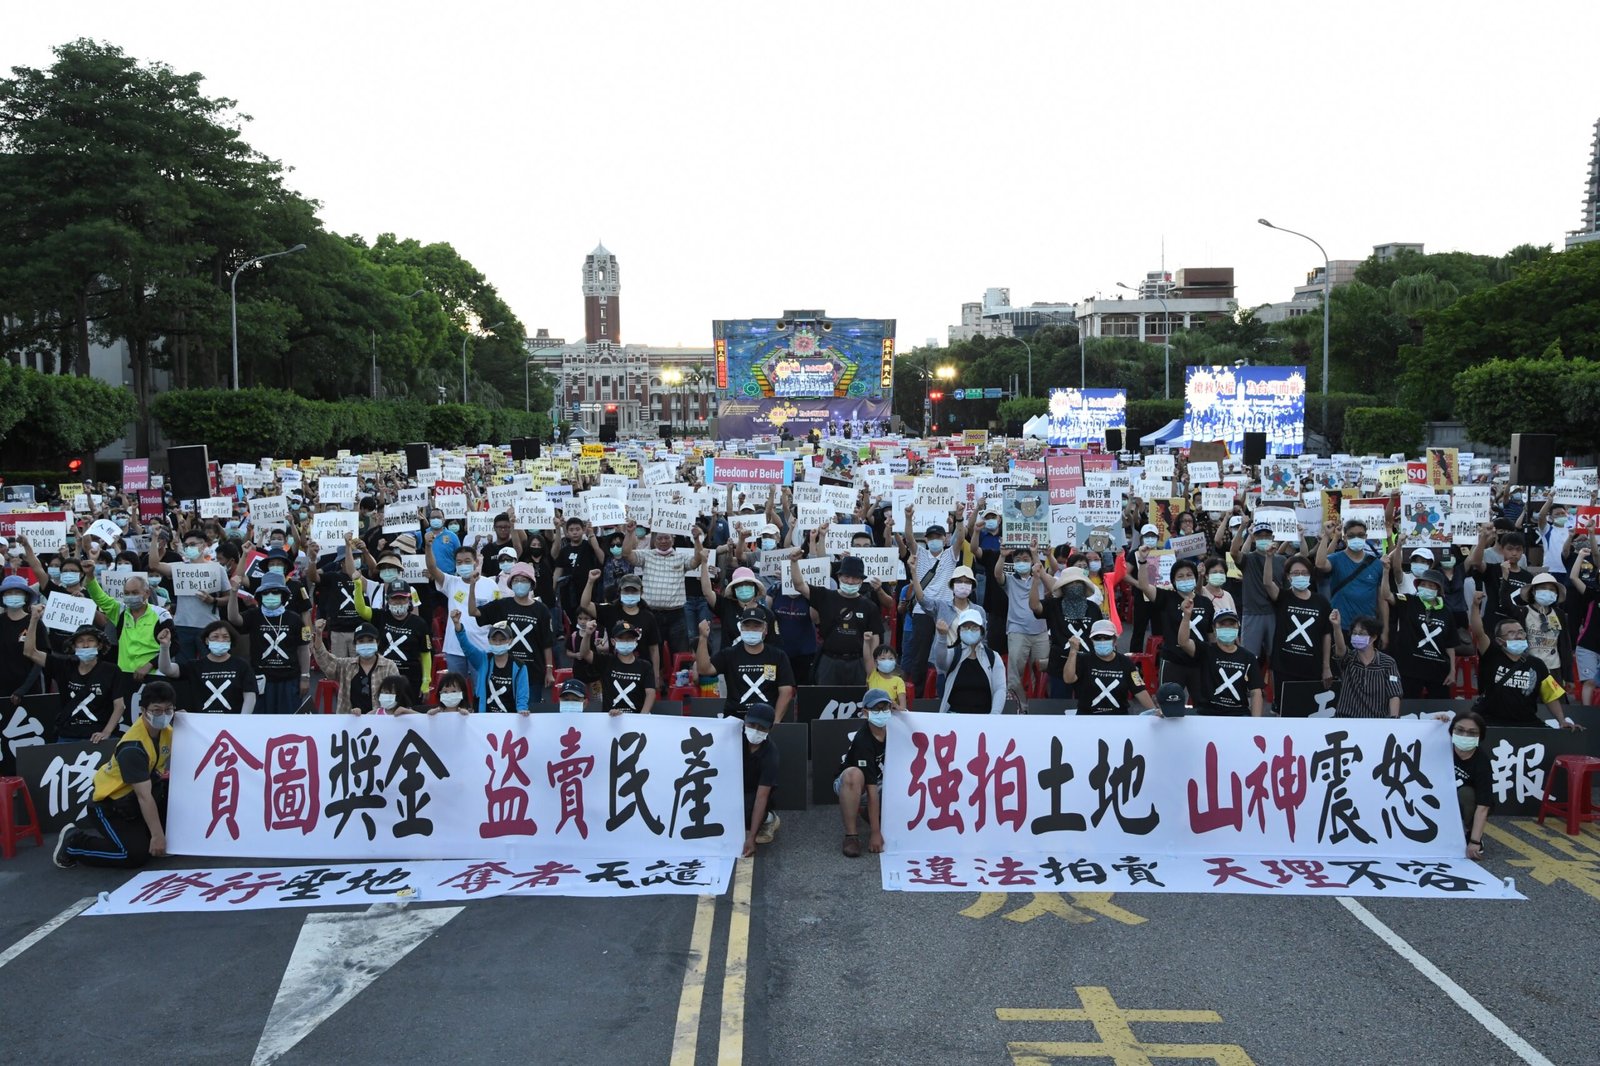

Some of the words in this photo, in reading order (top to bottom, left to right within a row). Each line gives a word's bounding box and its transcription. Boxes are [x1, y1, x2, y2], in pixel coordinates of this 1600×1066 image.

[124, 465, 148, 473] Freedom
[714, 466, 748, 477] Freedom
[749, 468, 758, 478] of
[760, 469, 784, 479] Belief
[1048, 465, 1080, 475] Freedom
[1380, 468, 1406, 476] Freedom
[1408, 468, 1426, 480] SO
[130, 481, 148, 489] Belief
[976, 476, 1010, 484] Freedom
[435, 486, 462, 496] SOS
[917, 483, 949, 493] Freedom
[491, 489, 518, 499] Freedom
[803, 493, 824, 502] Belief
[824, 489, 850, 499] Freedom
[1050, 490, 1059, 498] of
[1060, 489, 1076, 497] Beli
[1087, 489, 1111, 498] 執行署
[140, 495, 162, 504] Freedom
[833, 500, 854, 509] Belief
[927, 496, 954, 505] Belief
[1079, 500, 1120, 509] 搶奪民產!?
[253, 502, 279, 511] Freedom
[518, 505, 547, 513] Freedom
[801, 507, 828, 515] Freedom
[263, 511, 286, 519] Belief
[591, 513, 598, 521] of
[601, 512, 625, 520] Belief
[657, 507, 687, 519] Freedom
[517, 516, 525, 524] of
[528, 516, 552, 524] Belief
[0, 522, 16, 531] Free
[666, 520, 691, 531] Belief
[1006, 522, 1031, 531] 國稅局
[20, 527, 55, 536] Freedom
[314, 530, 323, 540] of
[33, 538, 62, 548] Belief
[825, 541, 833, 549] of
[837, 539, 849, 549] Bel
[1172, 536, 1204, 547] FREEDOM
[764, 554, 791, 563] Freedo
[855, 553, 889, 563] Freedom
[176, 569, 210, 577] Freedom
[786, 565, 820, 575] Fedom
[867, 566, 894, 576] Belief
[189, 579, 217, 590] Belief
[51, 597, 85, 613] Freedom
[45, 612, 56, 621] of
[60, 613, 89, 626] Belief
[1490, 739, 1557, 803] 報
[194, 729, 450, 841] 貪圖獎金
[479, 727, 724, 840] 盜賣民產
[1188, 731, 1440, 844] 山神震怒
[908, 856, 1165, 887] 違法拍賣
[1203, 857, 1486, 891] 天理不容
[129, 868, 411, 904] 修行聖地
[438, 860, 711, 893] 奪者天譴
